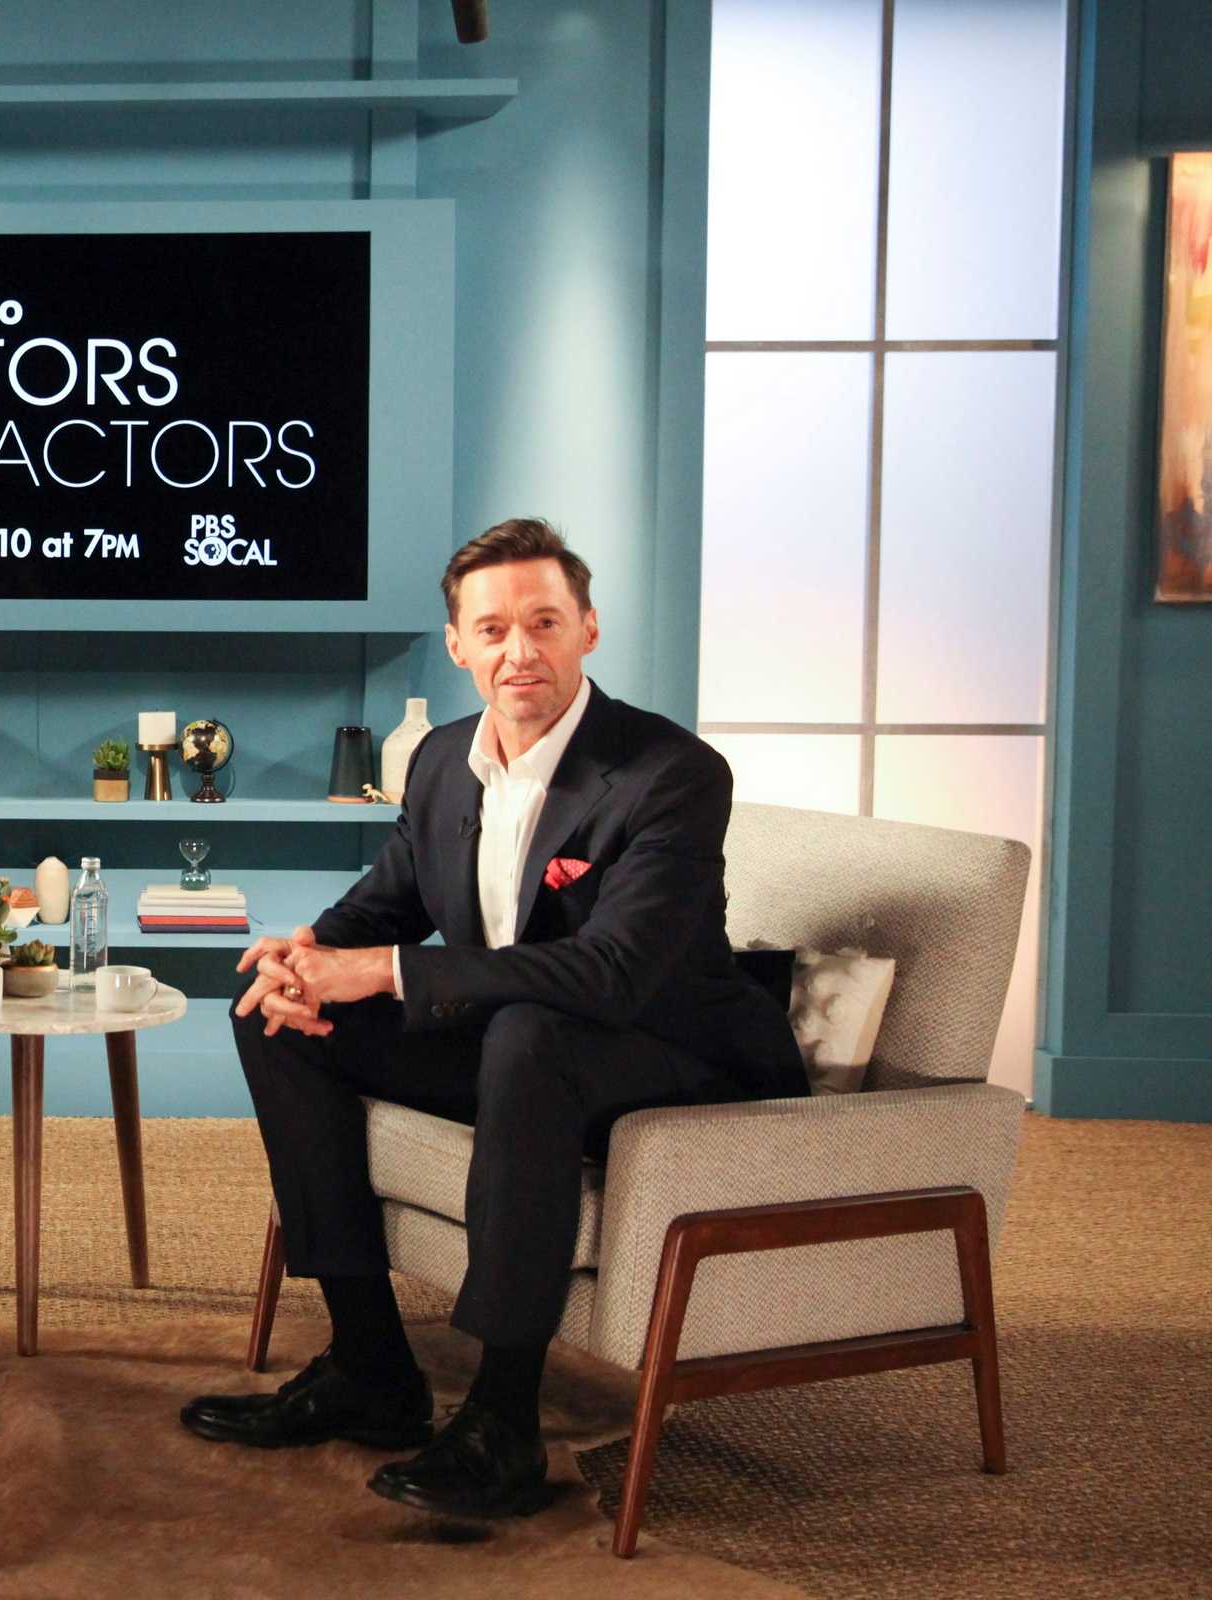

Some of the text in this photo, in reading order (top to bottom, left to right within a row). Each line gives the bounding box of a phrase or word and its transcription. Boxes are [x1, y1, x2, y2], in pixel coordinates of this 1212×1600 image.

[191, 514, 236, 538] PBS
[42, 532, 74, 558] at
[84, 528, 140, 558] 7PM
[183, 537, 278, 566] SOCAL
